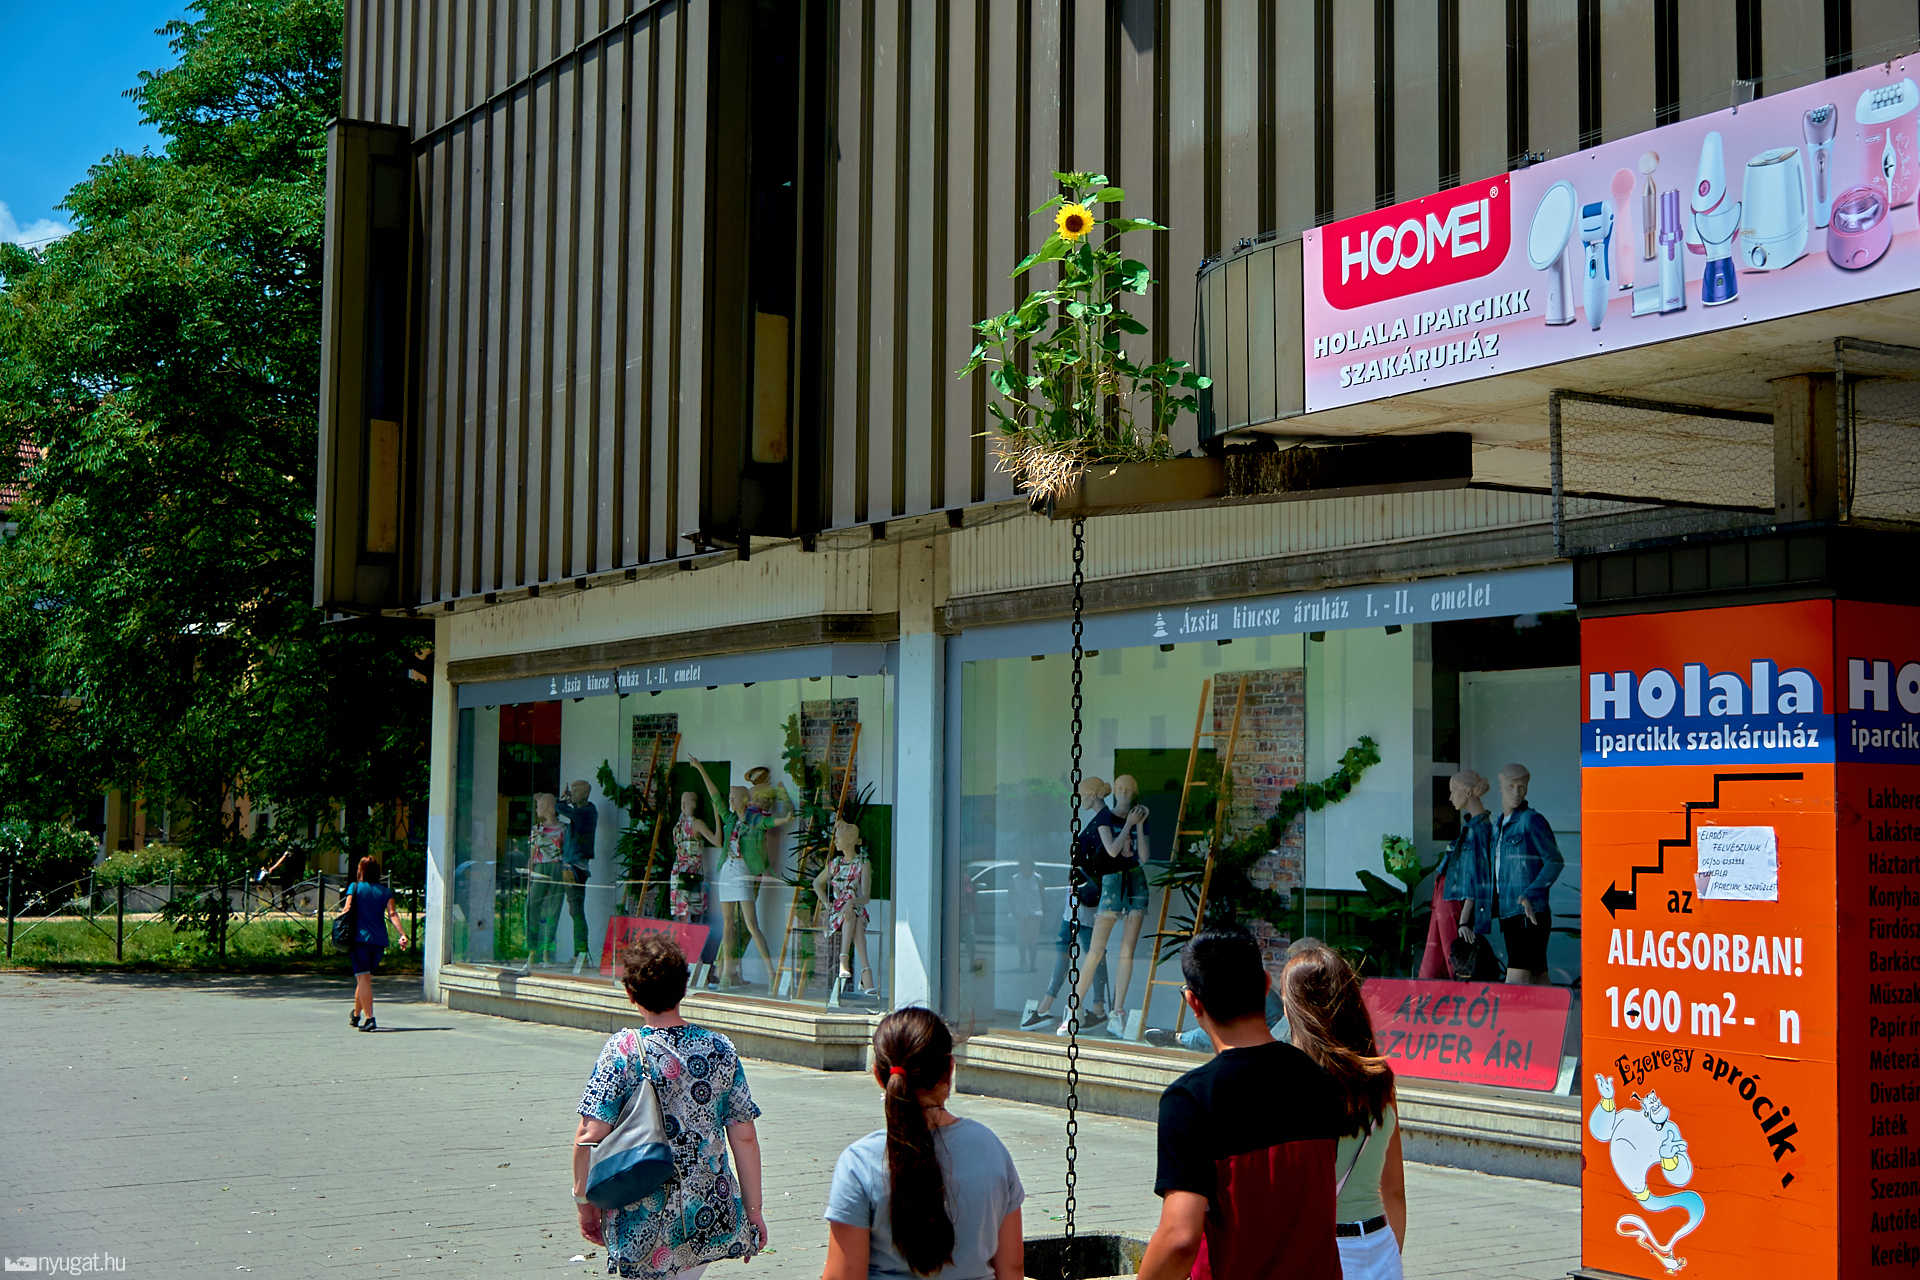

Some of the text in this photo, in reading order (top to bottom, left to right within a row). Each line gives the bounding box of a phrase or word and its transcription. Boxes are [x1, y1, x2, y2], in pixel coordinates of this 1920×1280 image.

[1341, 198, 1489, 286] HOOMEI
[1313, 288, 1530, 358] HOLALA IPARCIKK
[1340, 331, 1500, 388] SZAKÁRUHÁZ
[1180, 606, 1220, 635] Ázsia
[1232, 606, 1281, 630] kincse
[1294, 595, 1350, 624] áruház
[1430, 582, 1493, 612] emelet
[587, 673, 610, 691] kincse
[614, 670, 640, 689] ruház
[674, 664, 701, 683] emelet
[1589, 659, 1820, 720] Holala
[1594, 721, 1819, 759] iparcikk szakáruház
[1667, 890, 1692, 914] az
[1607, 928, 1803, 977] ALAGSORBAN!
[1393, 985, 1500, 1031] AKCIÓ!
[1605, 986, 1682, 1032] 1600
[1375, 1028, 1533, 1071] SZUPER ÁR!
[1614, 1048, 1695, 1086] Ezeregy
[1870, 1112, 1908, 1137] Játék
[1871, 1177, 1920, 1200] Szezon
